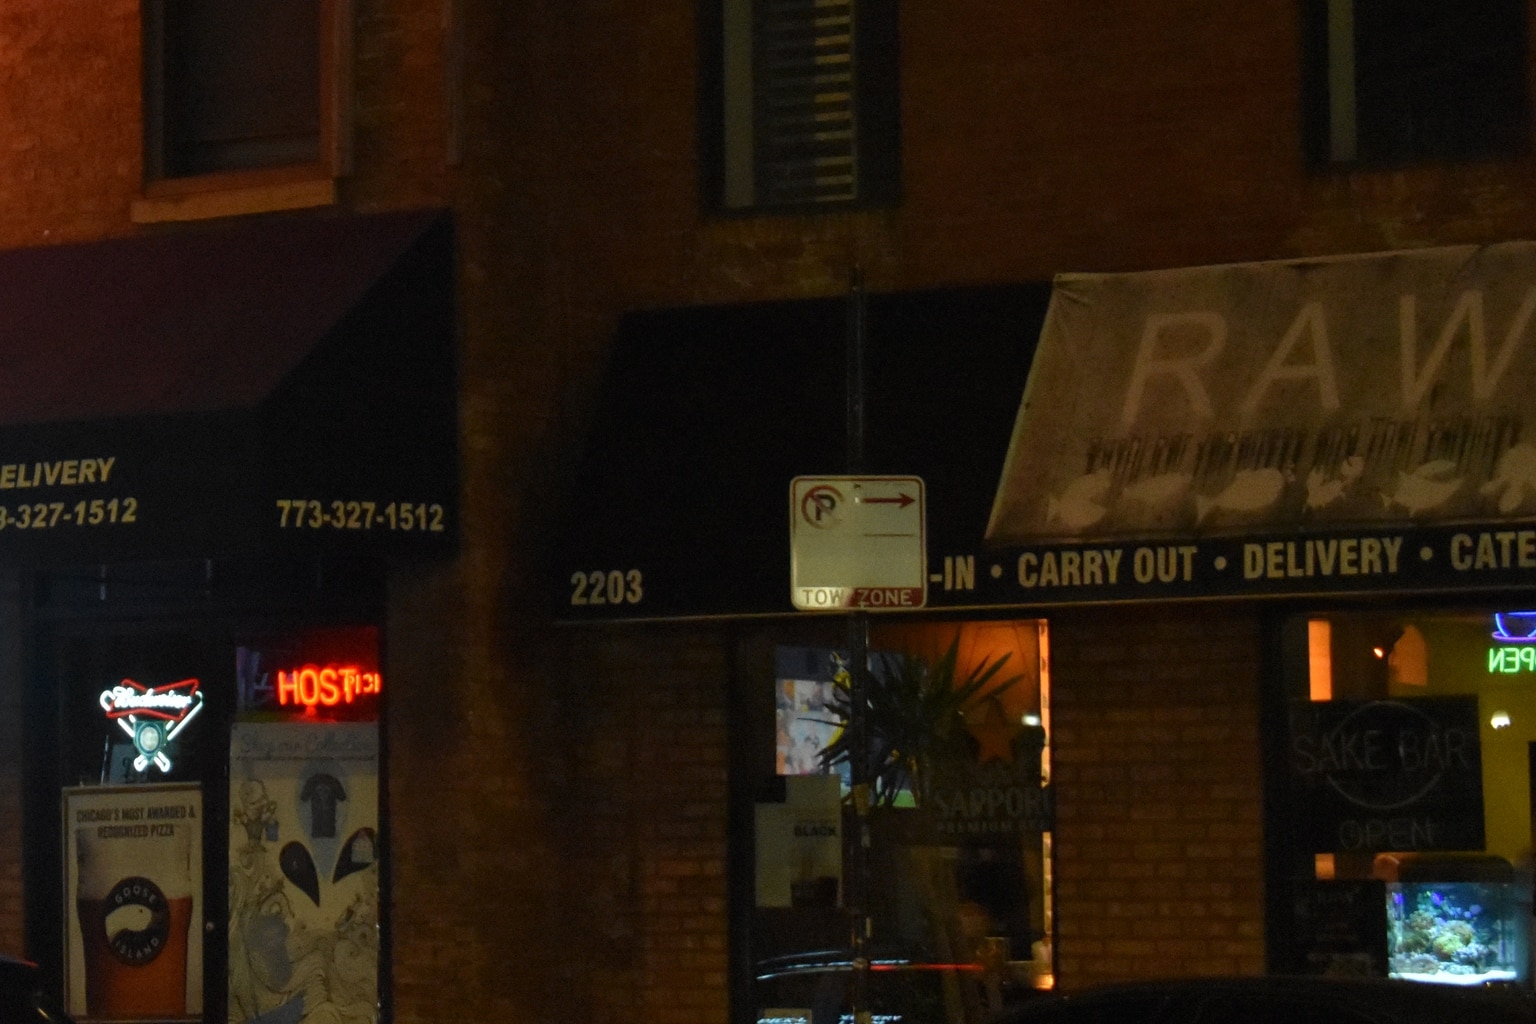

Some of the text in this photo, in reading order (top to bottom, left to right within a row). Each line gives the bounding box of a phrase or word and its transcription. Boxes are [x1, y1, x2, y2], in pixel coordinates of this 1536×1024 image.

[1119, 286, 1536, 429] RAW
[276, 499, 445, 532] 773-327-1512
[1016, 549, 1123, 589] CARRY
[1133, 545, 1199, 584] OUT
[1242, 537, 1404, 580] DELIVERY
[570, 570, 644, 606] 2203
[803, 589, 913, 606] TOW ZONE
[278, 667, 358, 706] HOST
[151, 822, 175, 838] PIZZA
[114, 884, 157, 904] GOOSE
[115, 936, 161, 961] ISLAND
